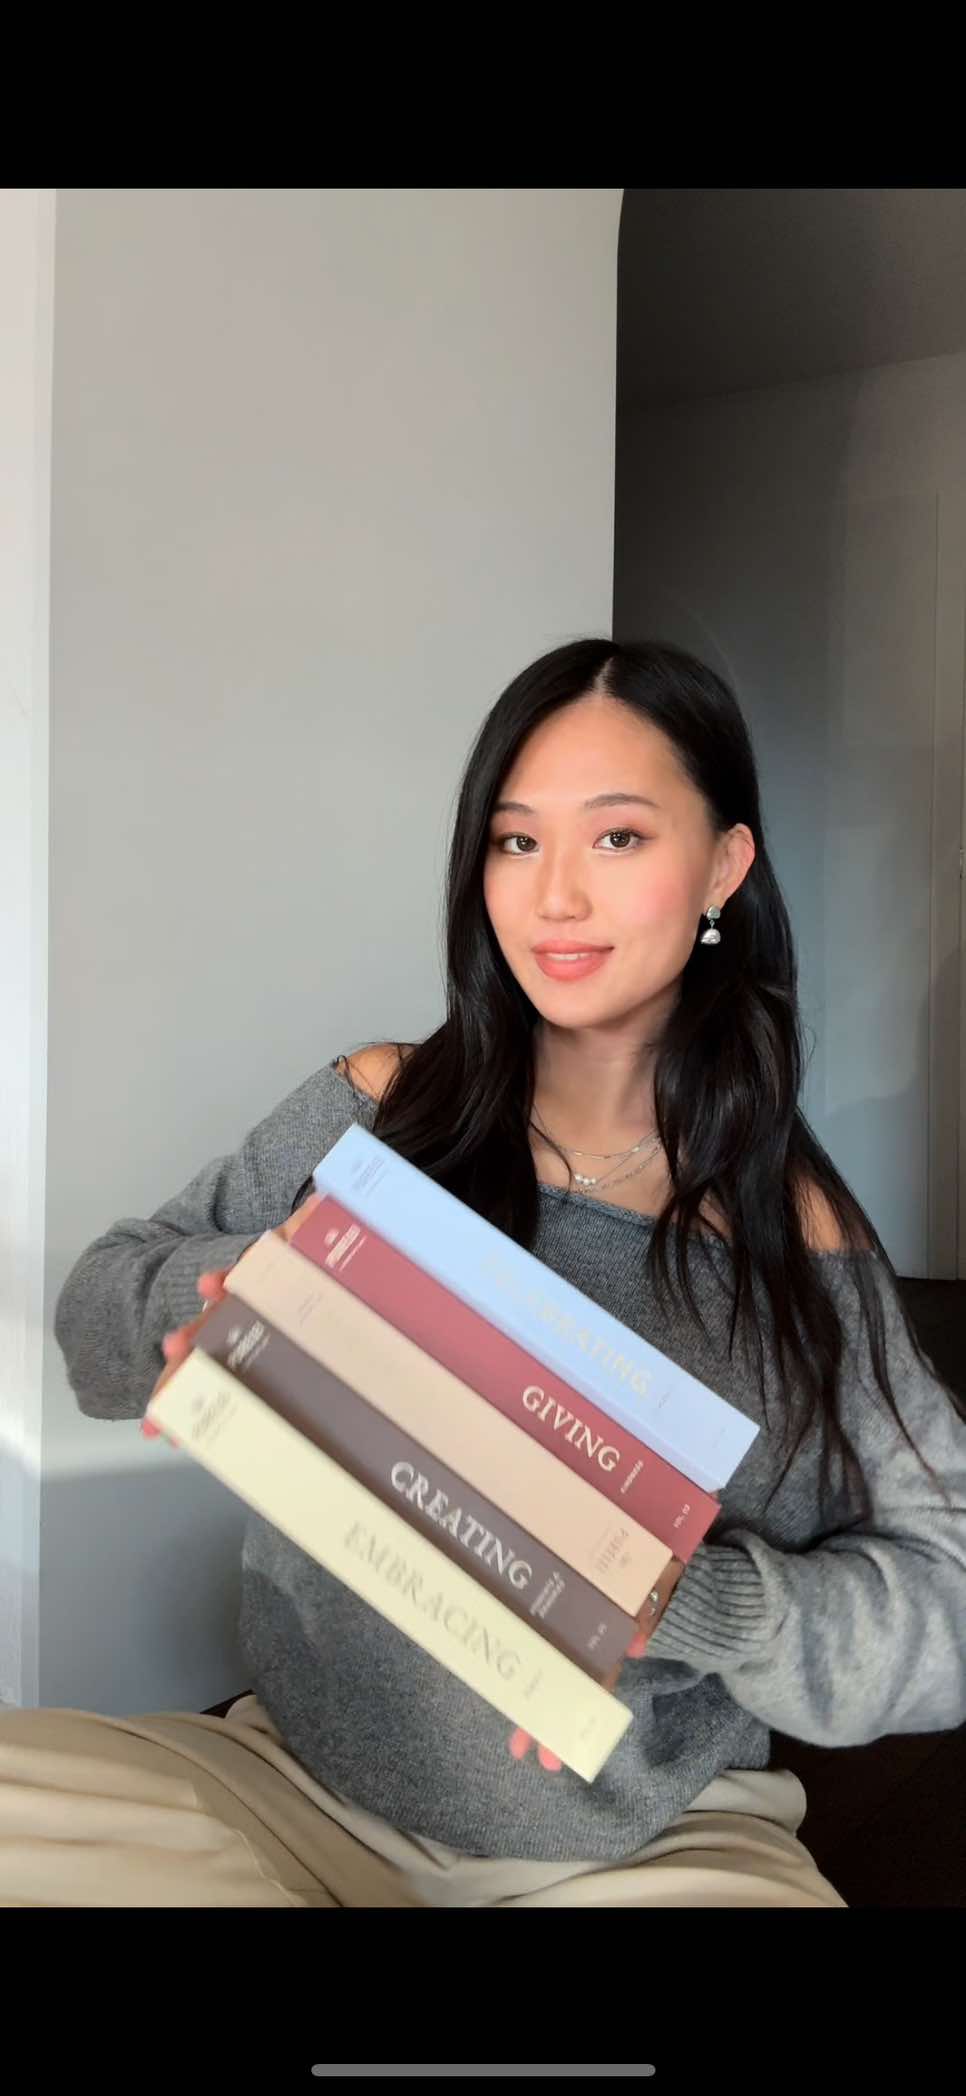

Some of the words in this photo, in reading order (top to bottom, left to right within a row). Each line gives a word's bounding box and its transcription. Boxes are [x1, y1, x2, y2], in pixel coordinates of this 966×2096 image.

[522, 1385, 620, 1472] GIVING
[390, 1460, 533, 1590] CREATING
[344, 1522, 521, 1680] EMBRACING
